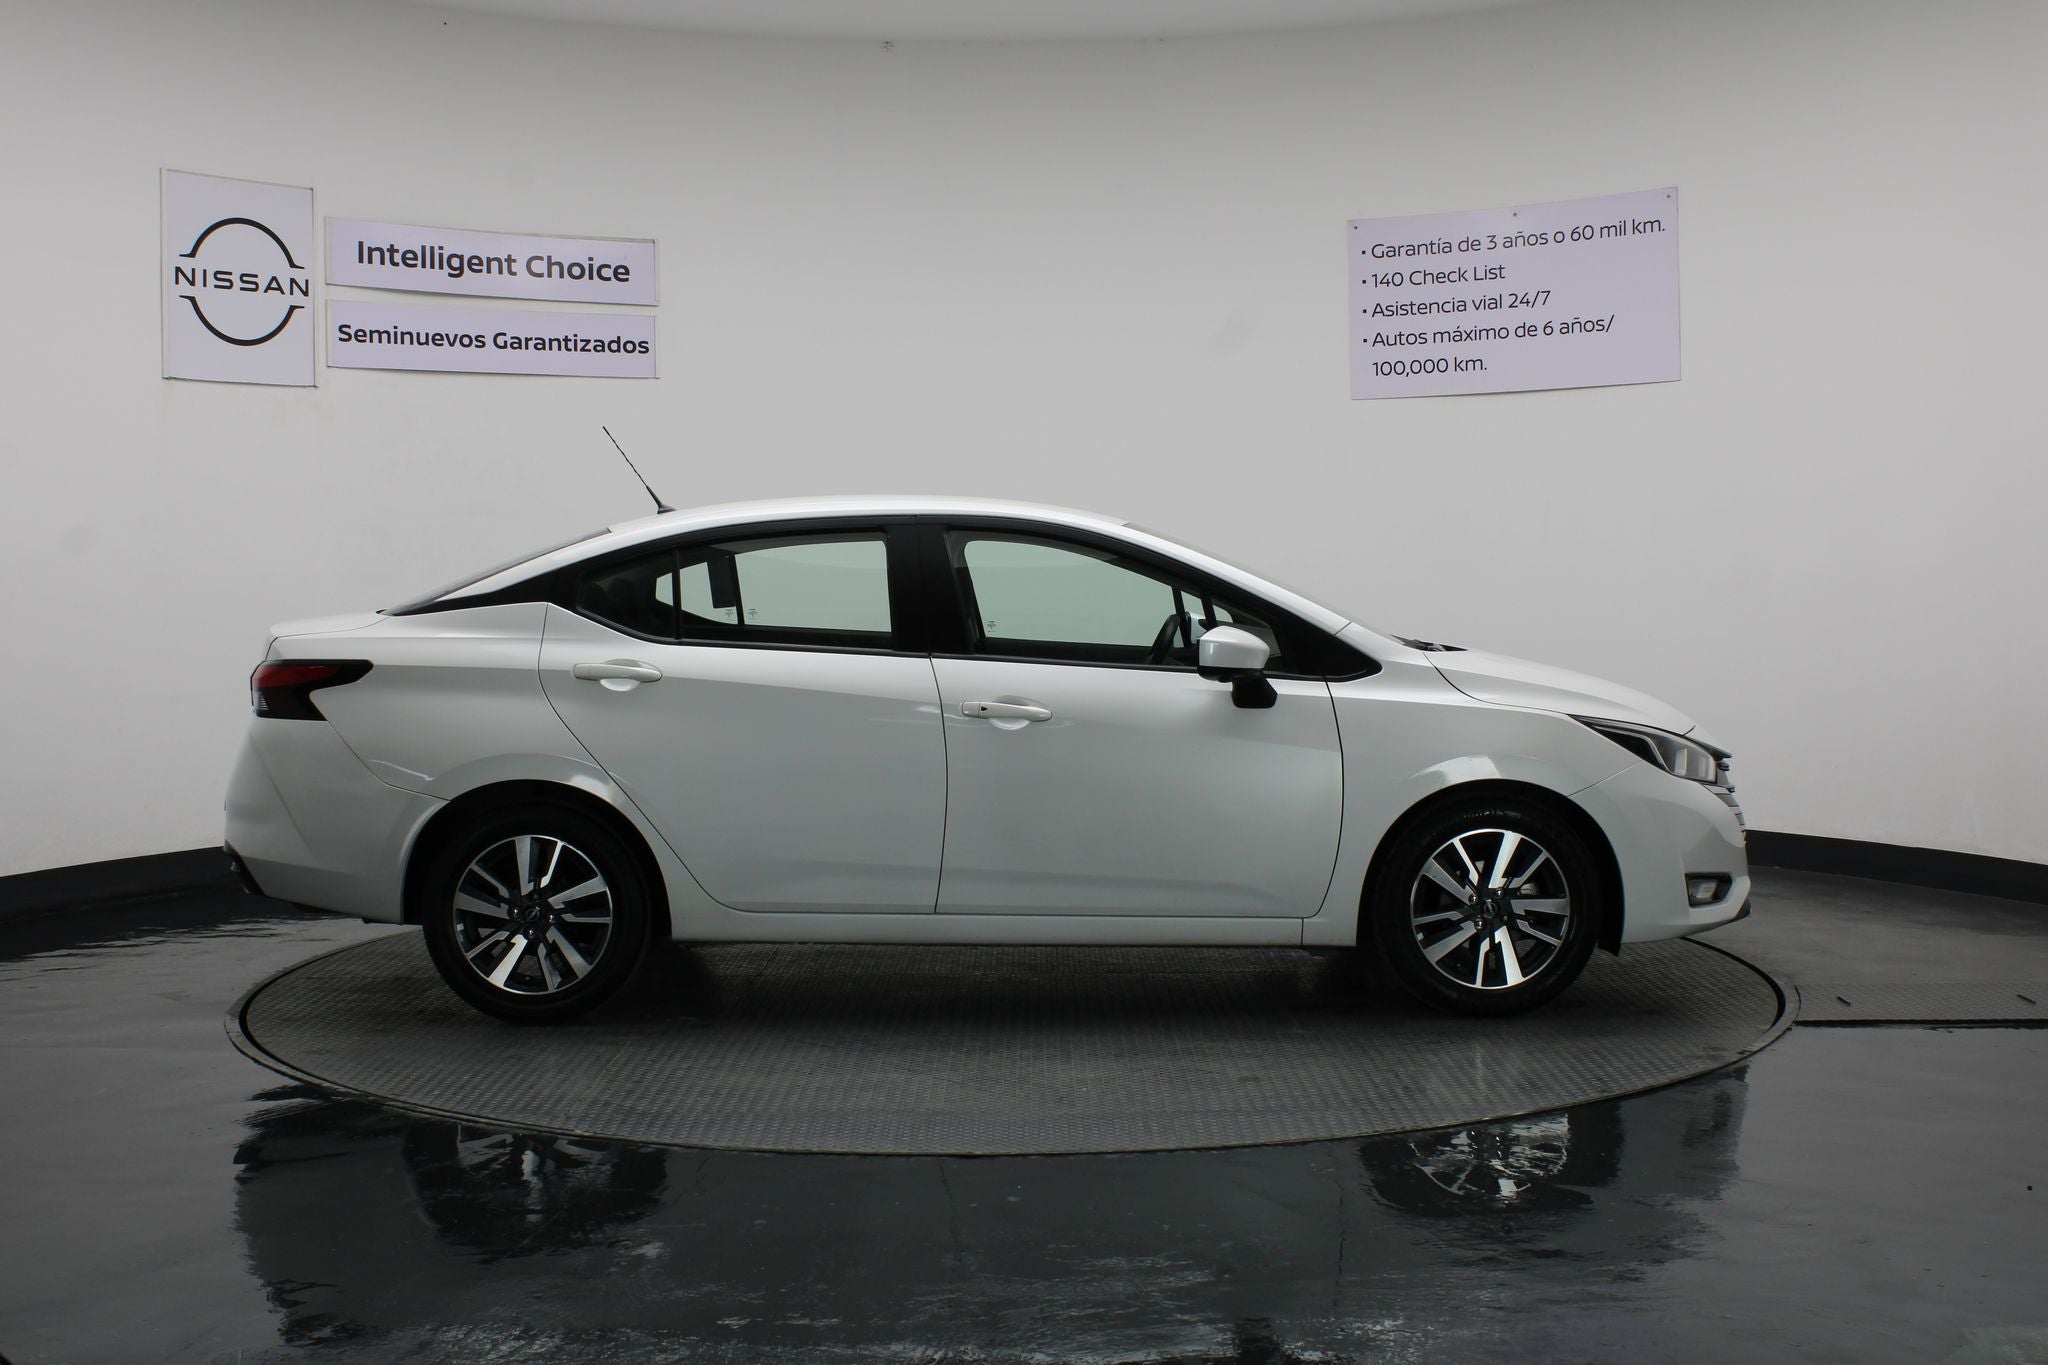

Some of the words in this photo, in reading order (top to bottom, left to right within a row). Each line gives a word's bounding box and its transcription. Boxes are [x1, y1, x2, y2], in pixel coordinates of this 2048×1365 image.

[1372, 238, 1452, 258] Garantía
[1458, 237, 1481, 252] de
[1487, 235, 1497, 250] 3
[1503, 231, 1548, 248] años
[1554, 231, 1565, 243] o
[1571, 225, 1594, 241] 60
[1600, 220, 1626, 238] mil
[1632, 219, 1665, 235] km.
[358, 241, 517, 278] Intelligent
[526, 255, 630, 282] Choice
[1372, 272, 1403, 288] 140
[1409, 267, 1468, 285] Check
[1474, 265, 1505, 281] List
[175, 266, 309, 298] NISSAN
[1372, 297, 1466, 317] Asistencia
[1472, 294, 1502, 310] vial
[1508, 290, 1551, 308] 24/7
[338, 324, 486, 348] Seminuevos
[493, 332, 649, 354] Garantizados
[1372, 329, 1427, 347] Autos
[1433, 326, 1509, 343] máximo
[1515, 322, 1537, 338] de
[1543, 321, 1553, 336] 6
[1560, 314, 1614, 334] años/
[1372, 358, 1448, 377] 100,000
[1455, 357, 1487, 372] km.
